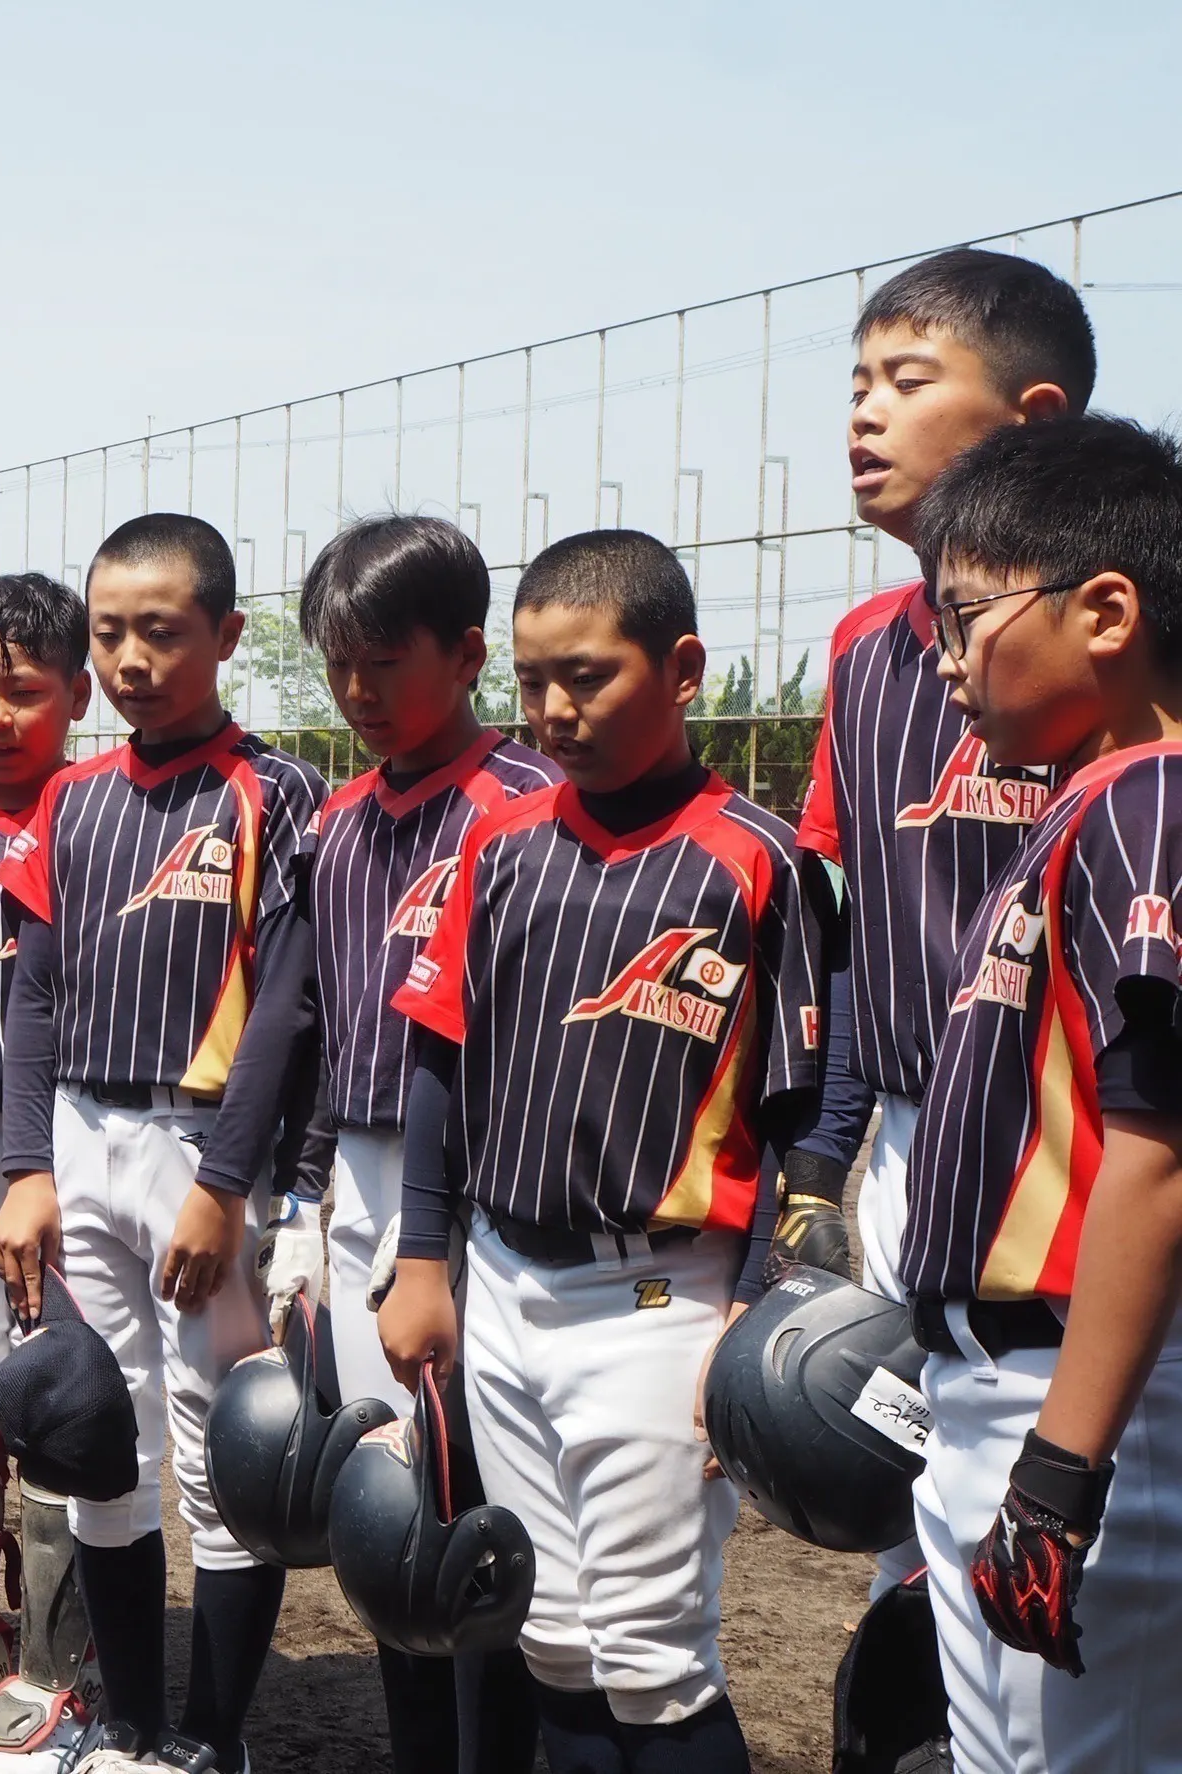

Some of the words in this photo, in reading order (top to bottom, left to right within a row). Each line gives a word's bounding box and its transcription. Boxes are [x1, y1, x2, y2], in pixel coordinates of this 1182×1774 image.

[117, 823, 233, 916] AKASHI
[560, 928, 727, 1044] AKASHI
[172, 1746, 200, 1764] asics
